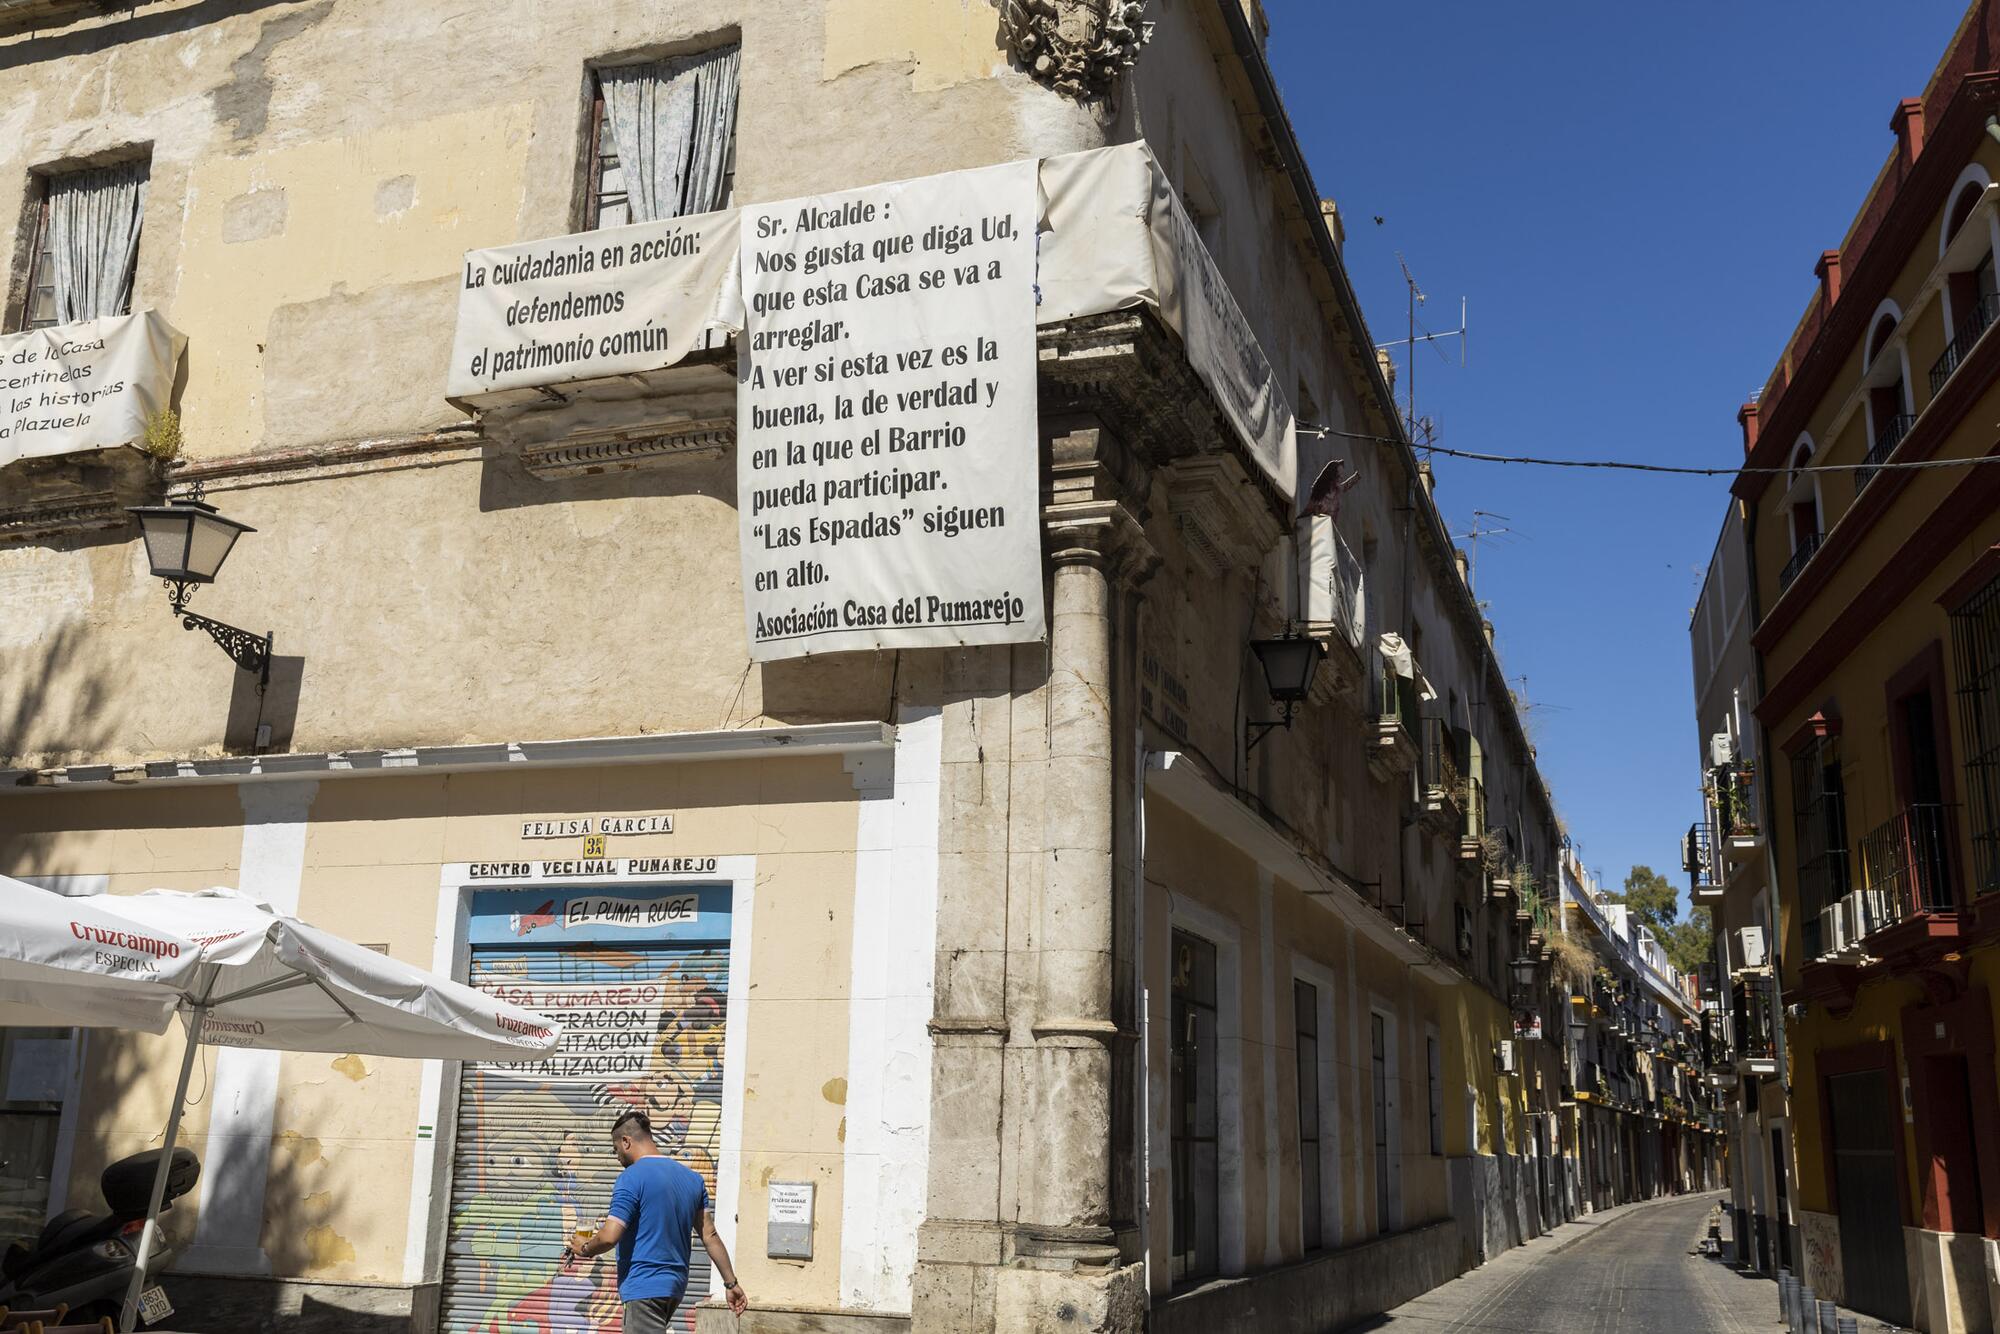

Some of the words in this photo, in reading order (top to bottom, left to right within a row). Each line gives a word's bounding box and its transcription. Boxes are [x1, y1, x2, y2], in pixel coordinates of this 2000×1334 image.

[756, 216, 788, 238] Sr.
[795, 200, 875, 233] Alcalde
[465, 262, 486, 289] La
[492, 245, 594, 286] cuidadania
[601, 247, 624, 270] en
[630, 227, 701, 263] acción:
[755, 250, 797, 274] Nos
[804, 241, 864, 275] gusta
[872, 233, 914, 263] que
[922, 224, 973, 254] diga
[981, 214, 1019, 242] Ud,
[753, 290, 795, 318] que
[803, 280, 848, 307] esta
[856, 272, 910, 299] Casa
[918, 269, 945, 290] se
[953, 264, 980, 286] va
[987, 259, 1002, 279] a
[506, 290, 625, 327] defendemos
[12, 349, 37, 365] de
[45, 346, 59, 361] la
[60, 338, 105, 356] Casa
[471, 348, 488, 377] el
[492, 333, 594, 380] patrimonio
[600, 320, 668, 357] común
[752, 319, 850, 351] arreglar.
[751, 365, 765, 391] A
[773, 365, 808, 387] ver
[814, 357, 834, 383] si
[840, 351, 888, 379] esta
[896, 348, 933, 372] vez
[941, 344, 968, 366] es
[976, 336, 999, 363] la
[10, 397, 33, 414] las
[39, 381, 124, 406] historias
[752, 403, 824, 430] buena,
[835, 394, 853, 420] la
[862, 389, 888, 417] de
[896, 377, 977, 411] verdad
[985, 381, 999, 408] y
[752, 448, 777, 470] en
[786, 440, 806, 466] la
[812, 438, 853, 467] que
[861, 429, 880, 456] el
[889, 421, 966, 453] Barrio
[753, 478, 816, 516] pueda
[823, 467, 948, 506] participar.
[923, 504, 1005, 537] siguen
[755, 570, 778, 592] en
[786, 559, 830, 588] alto.
[755, 601, 838, 639] Asociación
[843, 599, 887, 626] Casa
[892, 596, 922, 624] del
[926, 590, 1025, 626] Pumarejo
[523, 819, 591, 836] FELISA
[469, 863, 531, 877] CENTRO
[542, 860, 616, 875] VECINAL
[628, 857, 716, 873] PUMAREJO
[568, 901, 590, 923] EL
[595, 900, 640, 924] PUMA
[647, 898, 695, 922] RUGE
[70, 921, 180, 959] Cruzcampo
[95, 951, 161, 972] ESPECIAL
[545, 985, 658, 1008] PUMAREJO
[495, 1012, 554, 1040] Cruzcampo
